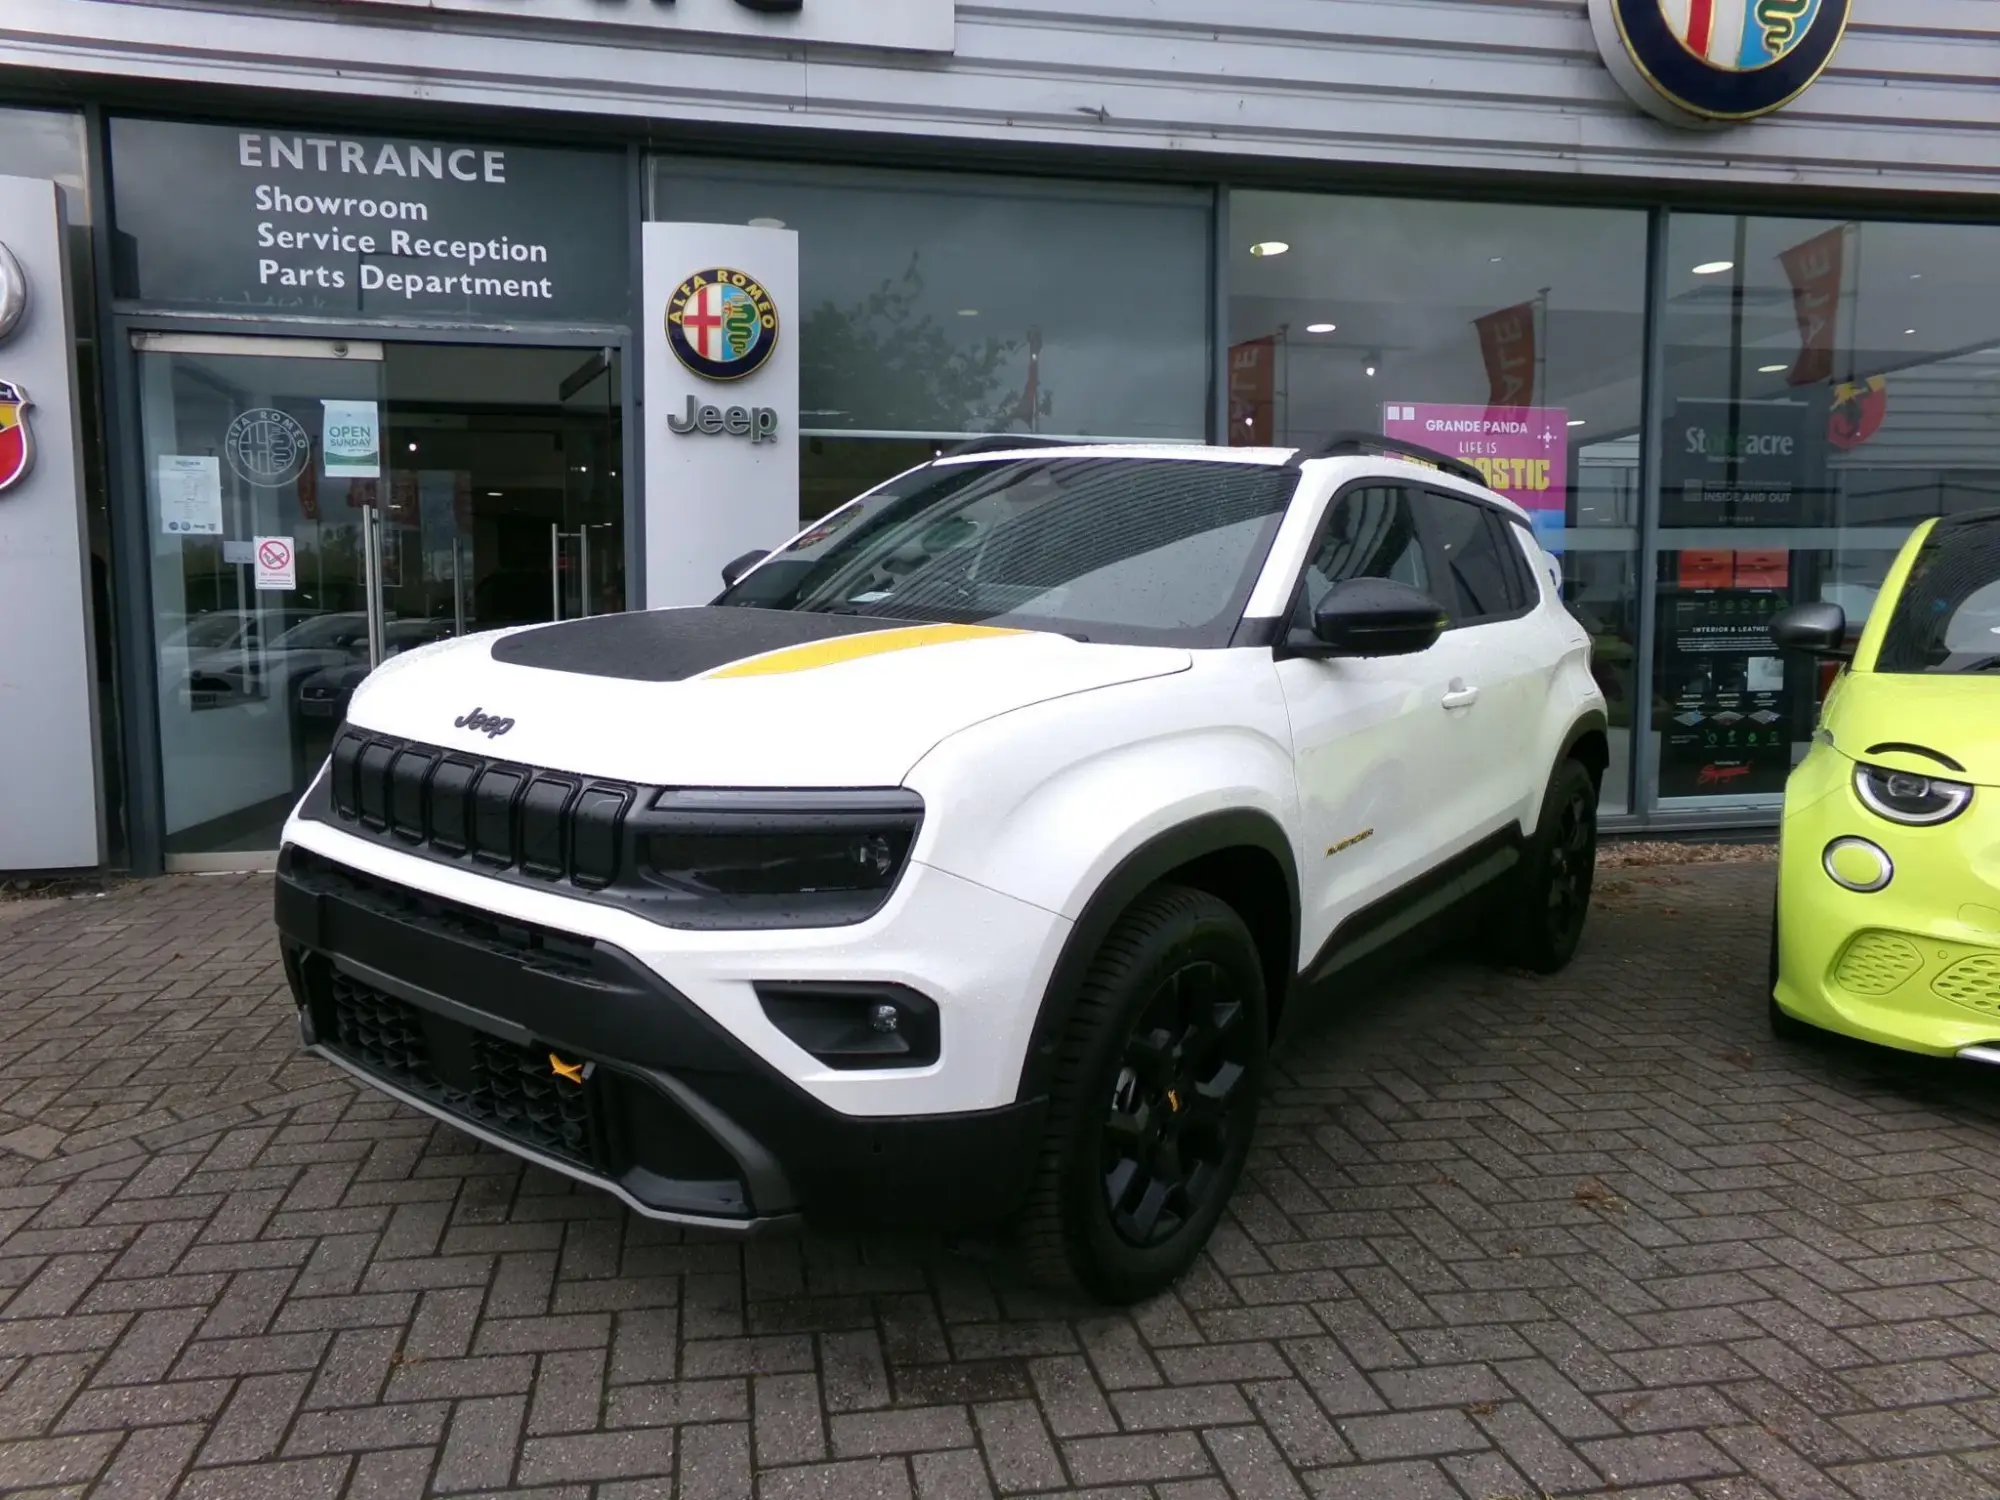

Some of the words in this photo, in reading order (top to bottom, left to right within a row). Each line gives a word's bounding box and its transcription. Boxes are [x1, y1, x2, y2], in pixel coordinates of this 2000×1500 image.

[238, 133, 506, 183] ENTRANCE
[255, 184, 428, 221] Showroom
[257, 222, 376, 253] Service
[390, 229, 547, 265] Reception
[259, 259, 345, 288] Parts
[359, 264, 552, 299] Department
[669, 275, 708, 324] ALFA
[717, 270, 775, 329] ROMEO
[260, 411, 306, 448] ROMEO
[329, 425, 371, 438] OPEN
[667, 394, 778, 443] Jeep
[1425, 419, 1481, 433] GRANDE
[1483, 421, 1528, 434] PANDA
[330, 438, 372, 447] SUNDAY
[1459, 441, 1482, 454] LIFE
[1486, 442, 1497, 454] IS
[454, 707, 515, 739] Jeep
